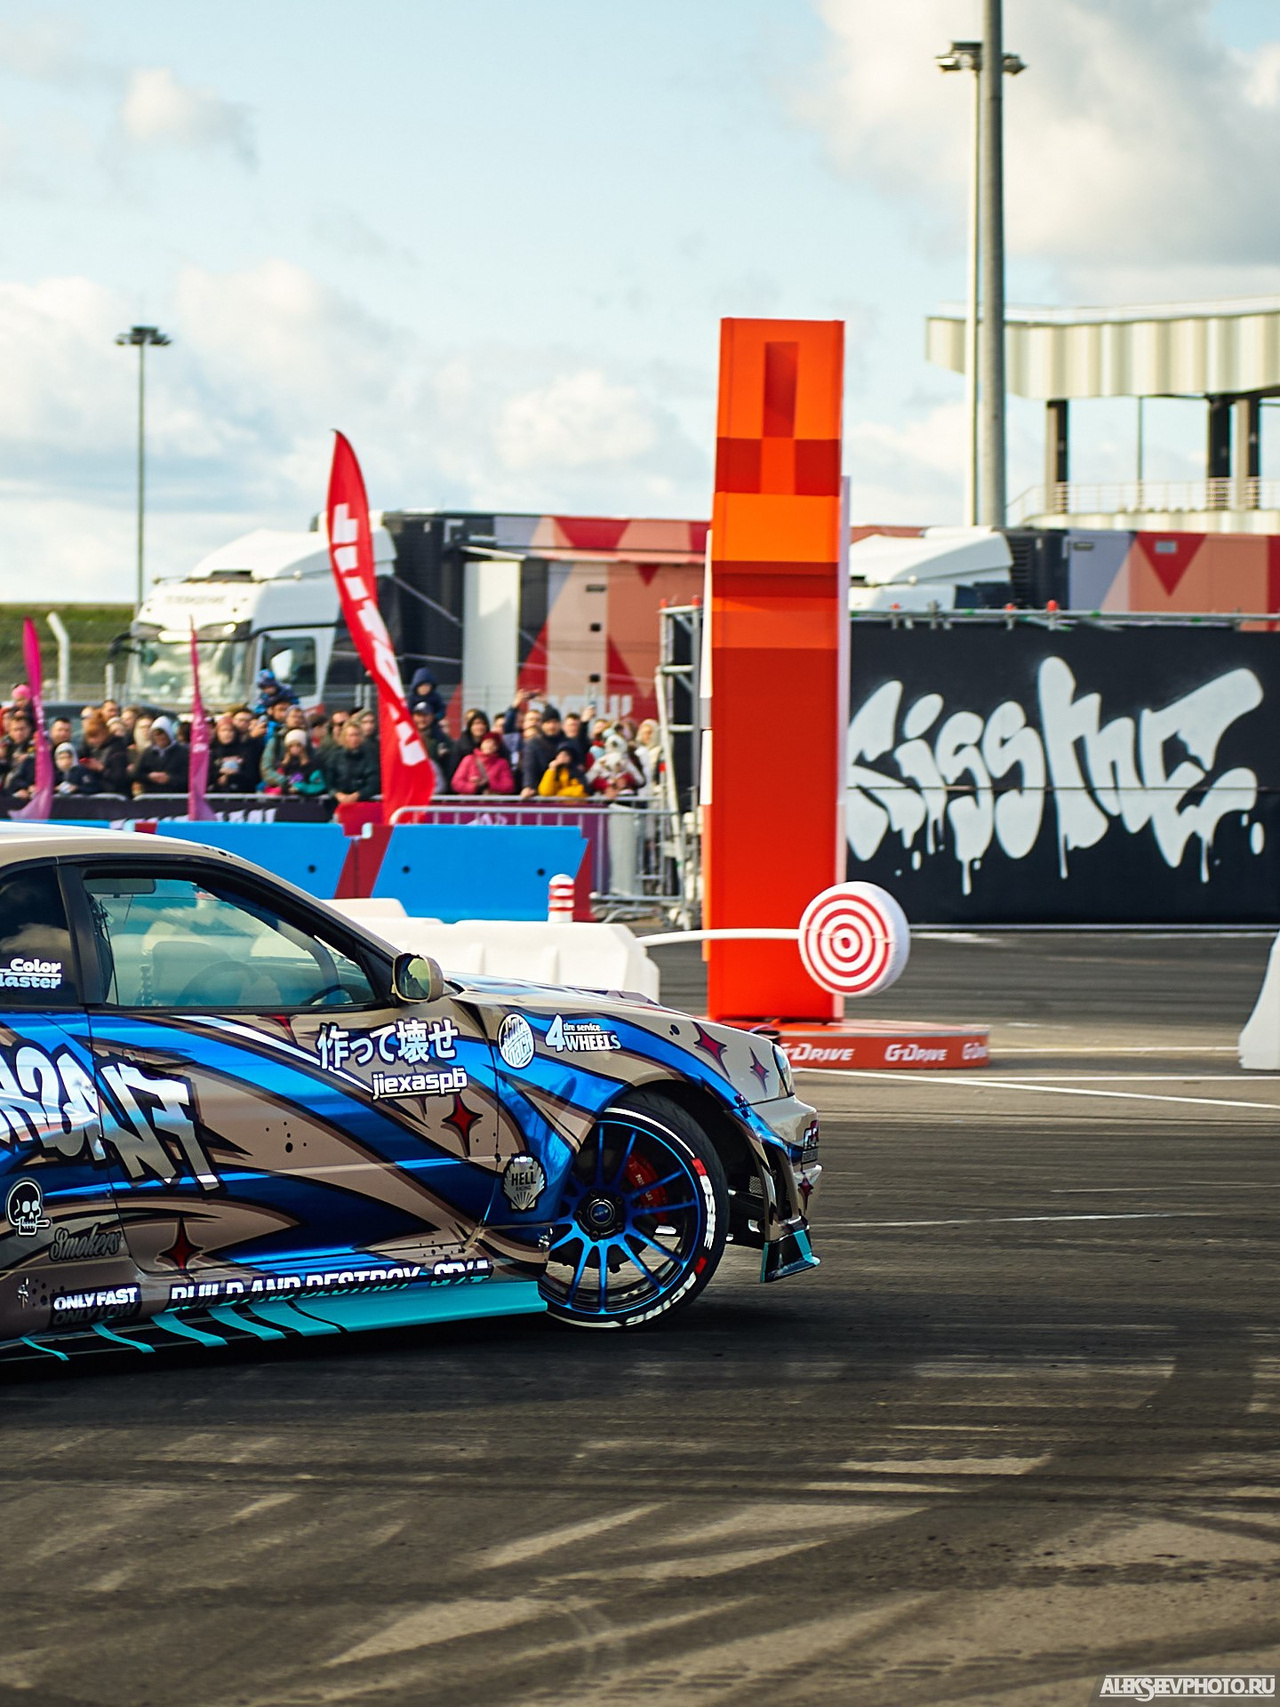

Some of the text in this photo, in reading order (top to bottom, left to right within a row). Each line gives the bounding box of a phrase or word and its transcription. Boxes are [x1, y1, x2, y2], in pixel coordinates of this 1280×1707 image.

[10, 957, 62, 973] Color
[545, 1013, 622, 1052] 4 WHEELS
[563, 1023, 601, 1032] tire service
[317, 1017, 459, 1070] 作って壊せ
[511, 1171, 537, 1187] HELL
[50, 1224, 122, 1261] Smokers
[53, 1287, 138, 1311] ONLY FAST
